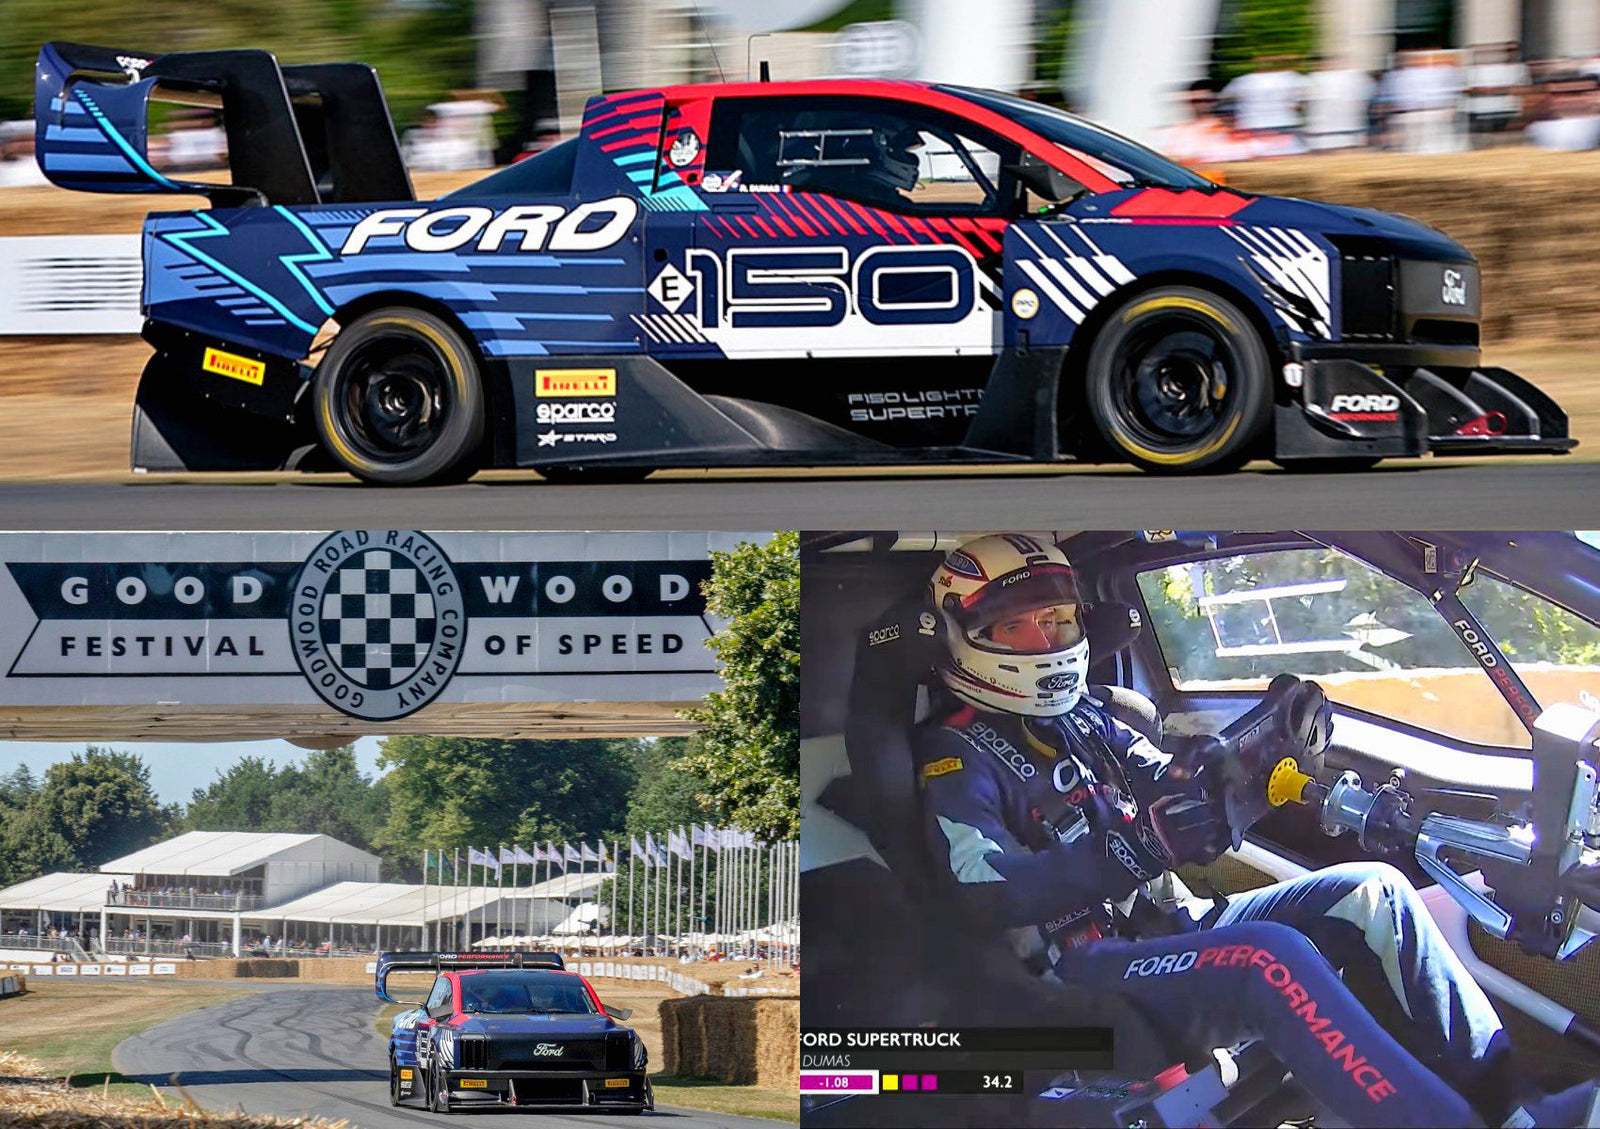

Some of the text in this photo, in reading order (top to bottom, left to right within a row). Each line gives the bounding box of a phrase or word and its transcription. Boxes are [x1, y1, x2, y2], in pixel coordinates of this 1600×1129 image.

[340, 196, 637, 255] FORD
[661, 276, 679, 301] E
[685, 244, 979, 329] 150
[543, 376, 608, 390] PIRELLI
[536, 402, 616, 424] sparco
[1331, 395, 1400, 411] FORD
[61, 574, 690, 605] GOOD WOOD
[1002, 571, 1031, 587] FORD
[298, 530, 458, 708] GOODWOOD ROAD RACING COMPANY
[61, 634, 683, 656] FESTIVAL OF SPEED
[869, 624, 900, 646] sparco
[1454, 619, 1498, 667] FORD
[969, 721, 1037, 782] sparco
[1110, 839, 1148, 880] sparc
[1123, 944, 1397, 1104] FORD PERFORMANCE
[533, 1042, 565, 1057] Ford
